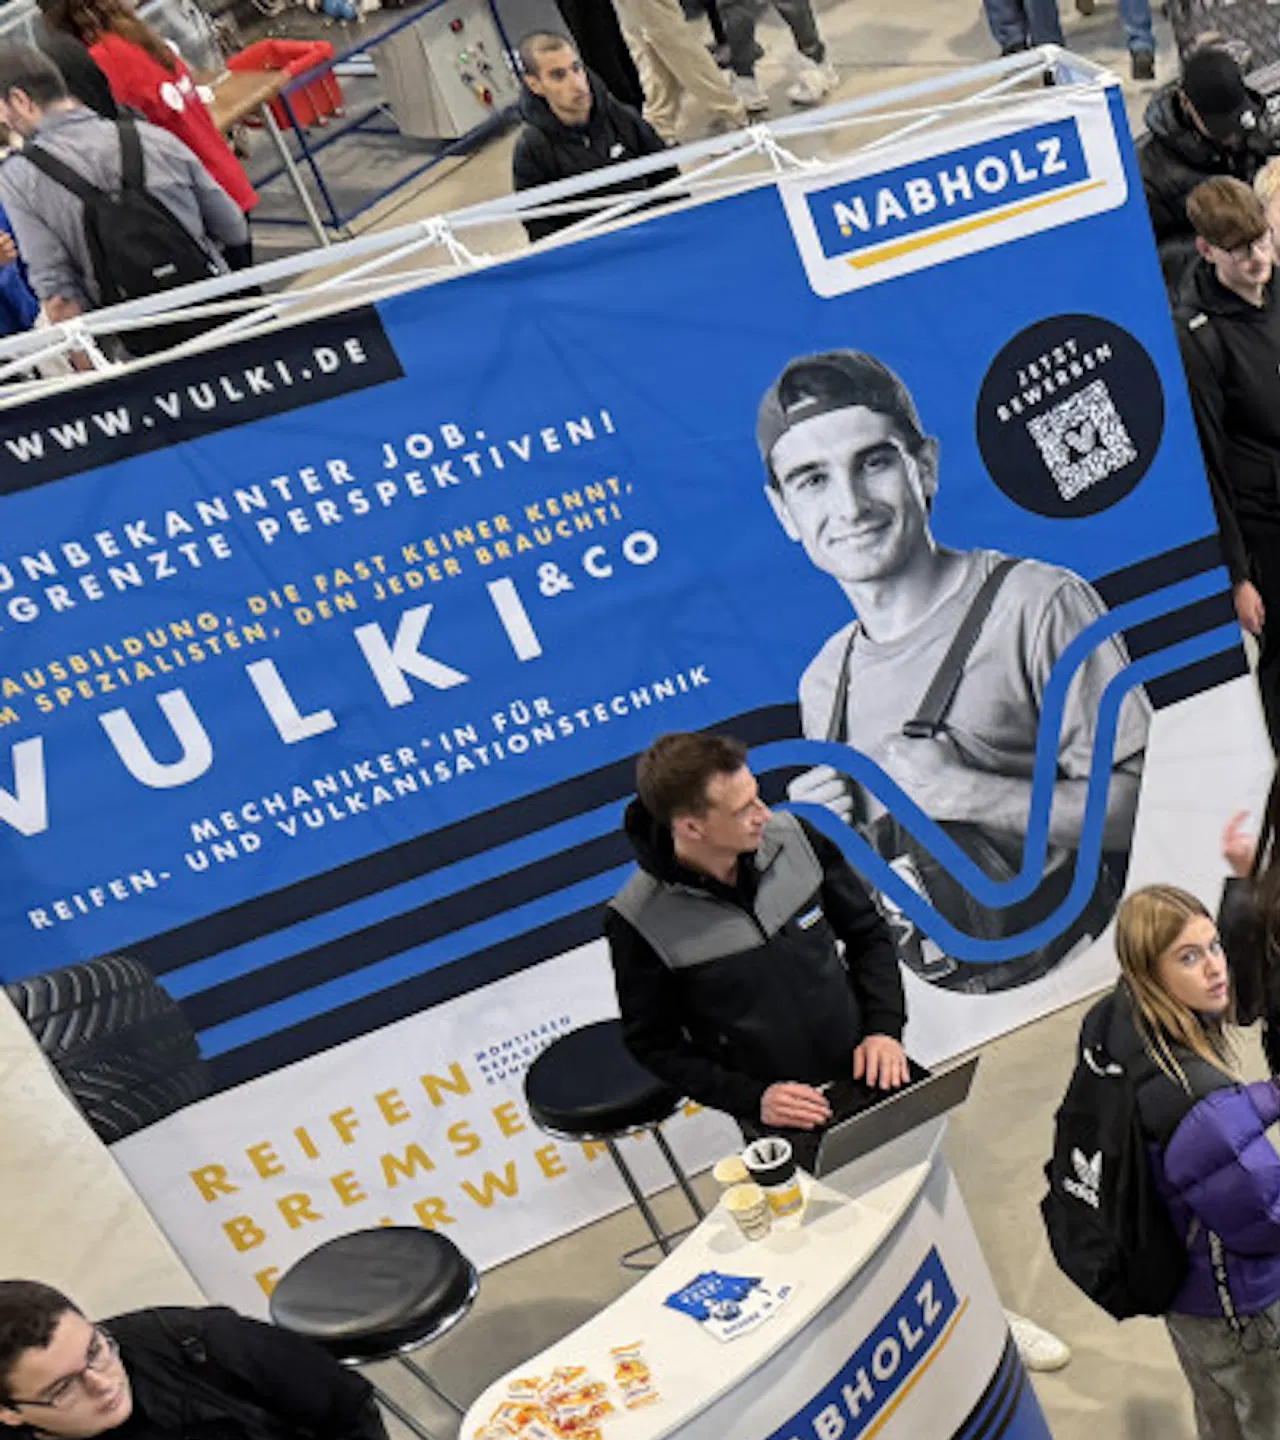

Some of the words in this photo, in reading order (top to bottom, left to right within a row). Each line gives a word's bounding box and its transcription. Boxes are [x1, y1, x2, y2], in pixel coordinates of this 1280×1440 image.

[832, 137, 1067, 236] NABHOLZ
[5, 338, 366, 462] WWW.VULKI.DE
[383, 423, 486, 469] JOB.
[256, 410, 615, 544] PERSPEKTIVEN!
[2, 612, 233, 698] AUSBILDUNG,
[248, 584, 300, 615] DIE
[313, 556, 387, 593] FAST
[402, 514, 512, 565] KEINER
[525, 477, 633, 523] KENNT,
[35, 622, 281, 712] SPEZIALISTEN,
[295, 591, 358, 626] DEN
[373, 557, 462, 601] JEDER
[475, 502, 622, 566] BRAUCHT!
[537, 530, 659, 597] &CO
[492, 697, 555, 733] FÜR
[28, 869, 171, 930] REIFEN-
[184, 832, 261, 872] UND
[277, 665, 711, 837] VULKANISATIONSTECHNIK
[189, 1061, 473, 1202] REIFEN
[222, 1100, 527, 1252] BREMSE
